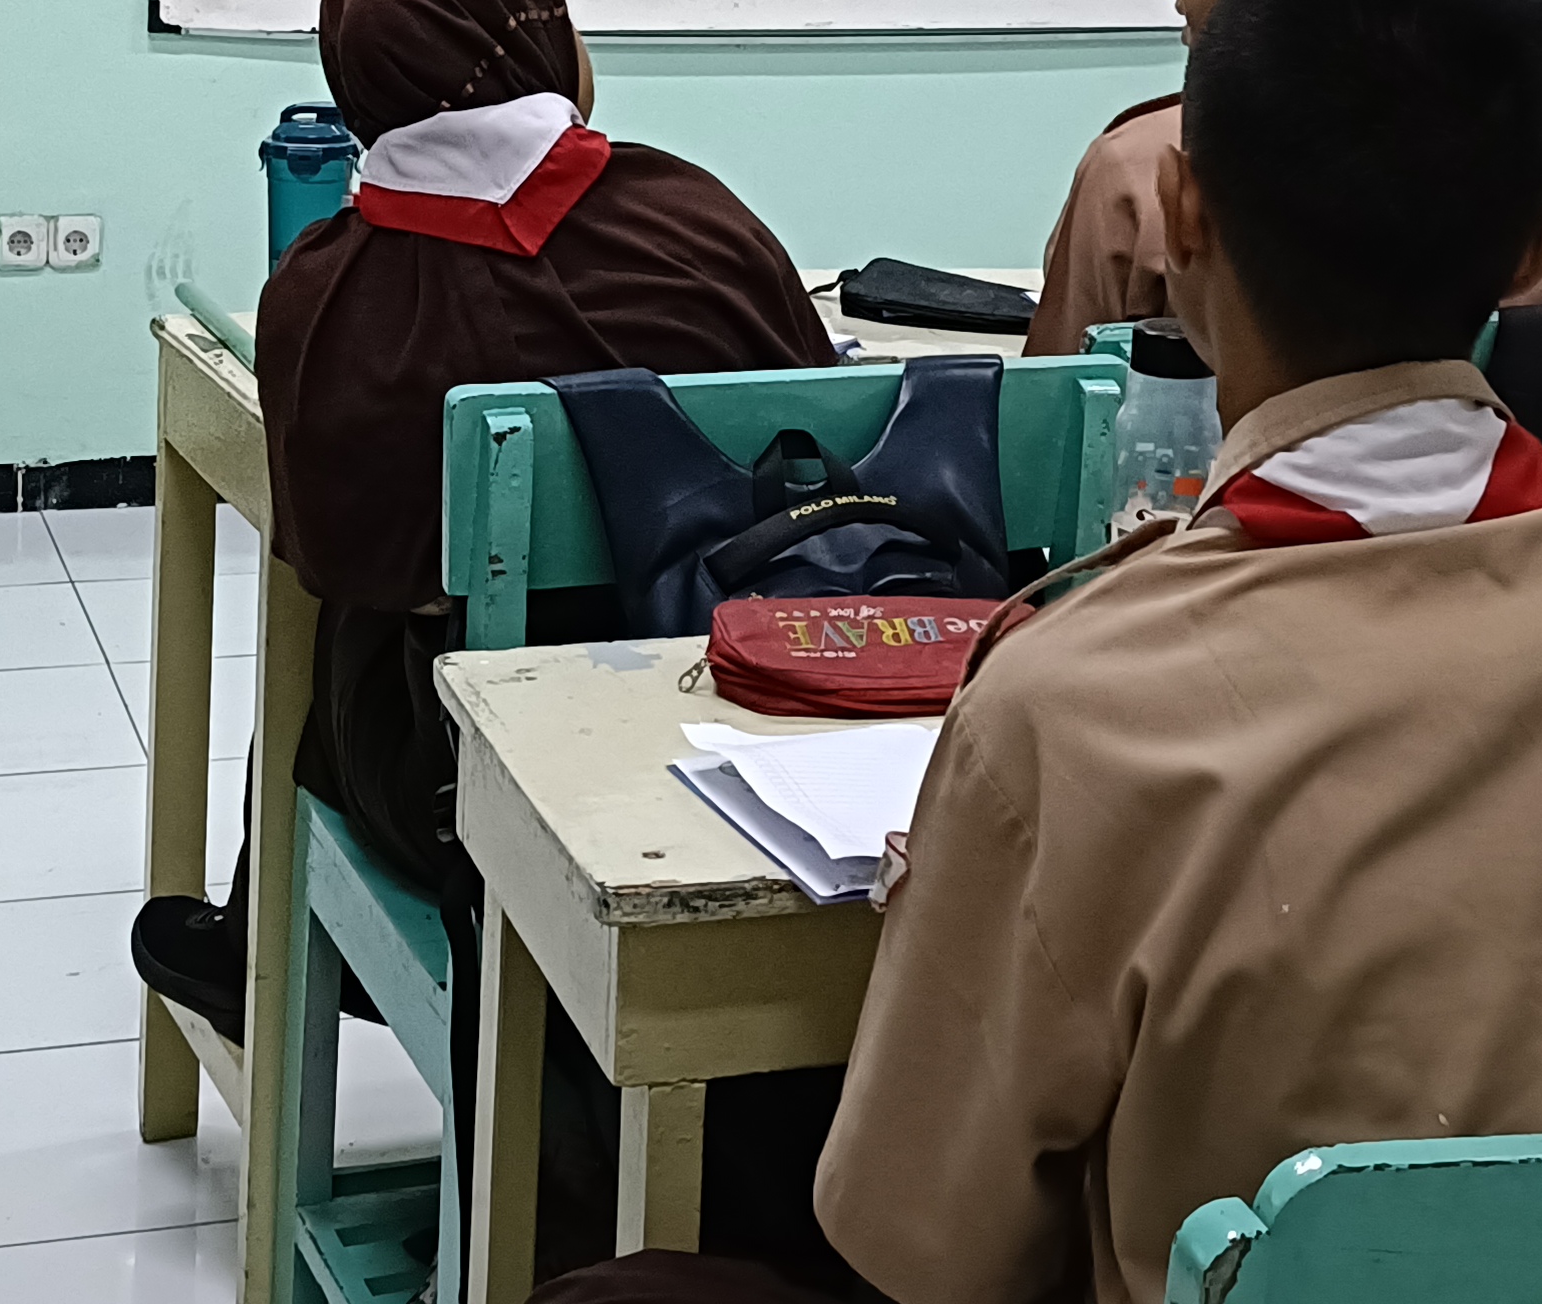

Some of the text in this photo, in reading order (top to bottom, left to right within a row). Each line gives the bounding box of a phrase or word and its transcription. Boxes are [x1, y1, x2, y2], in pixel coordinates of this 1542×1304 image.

[790, 495, 898, 520] POLO MILANO
[777, 616, 946, 650] BRAVE
